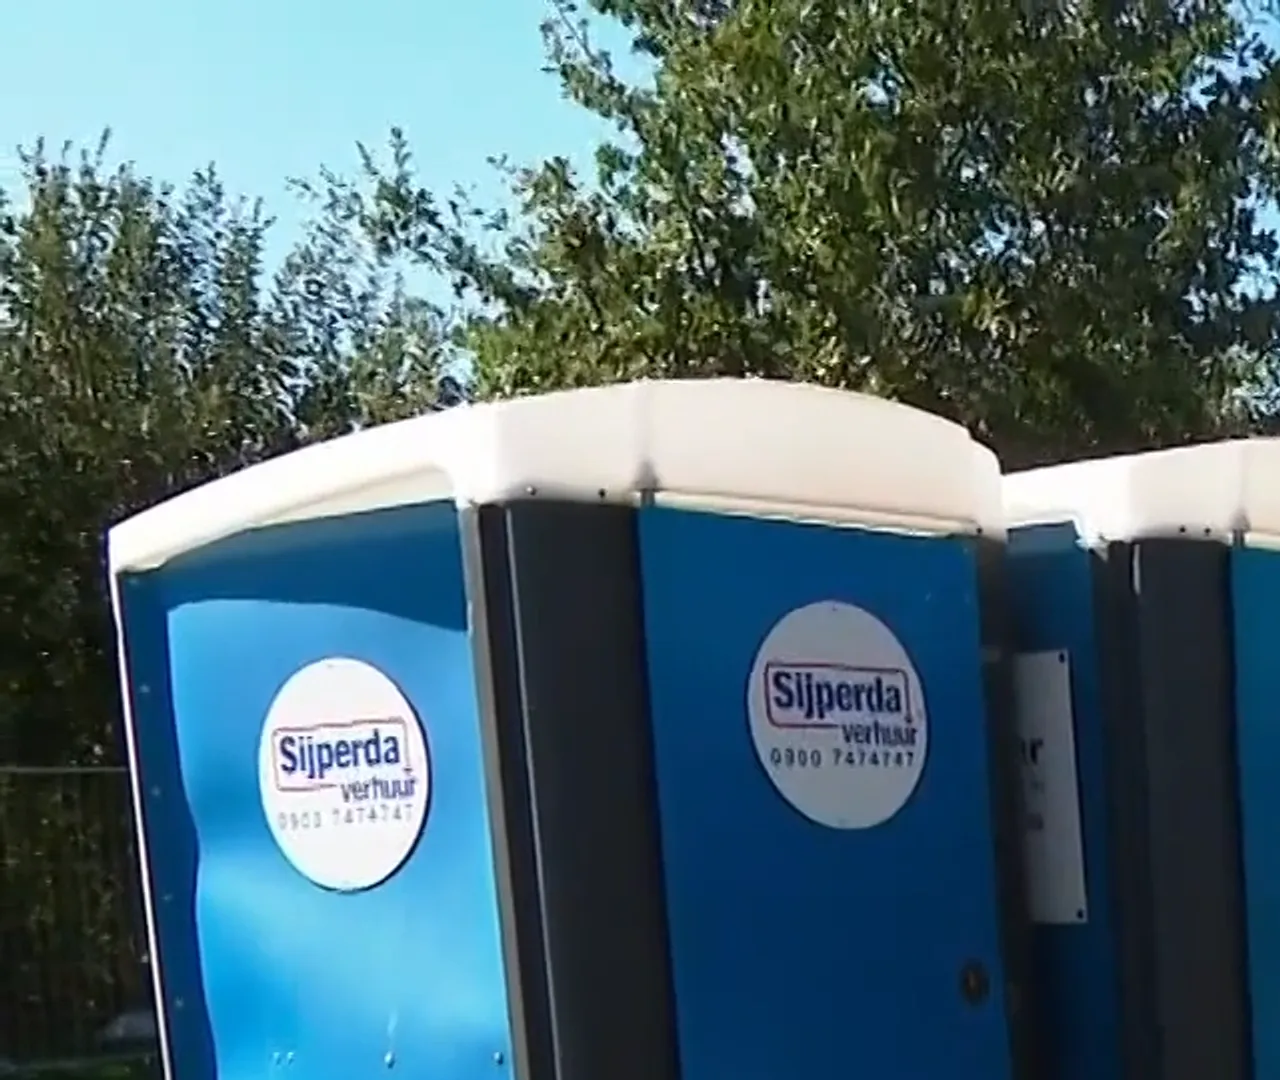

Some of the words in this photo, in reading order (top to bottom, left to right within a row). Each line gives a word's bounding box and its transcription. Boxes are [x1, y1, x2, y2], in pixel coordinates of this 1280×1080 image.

[772, 671, 901, 719] Sijperda
[841, 720, 918, 747] verhuur
[279, 728, 400, 779] Sijperda
[833, 748, 915, 767] 7474747
[340, 776, 416, 803] verhuur
